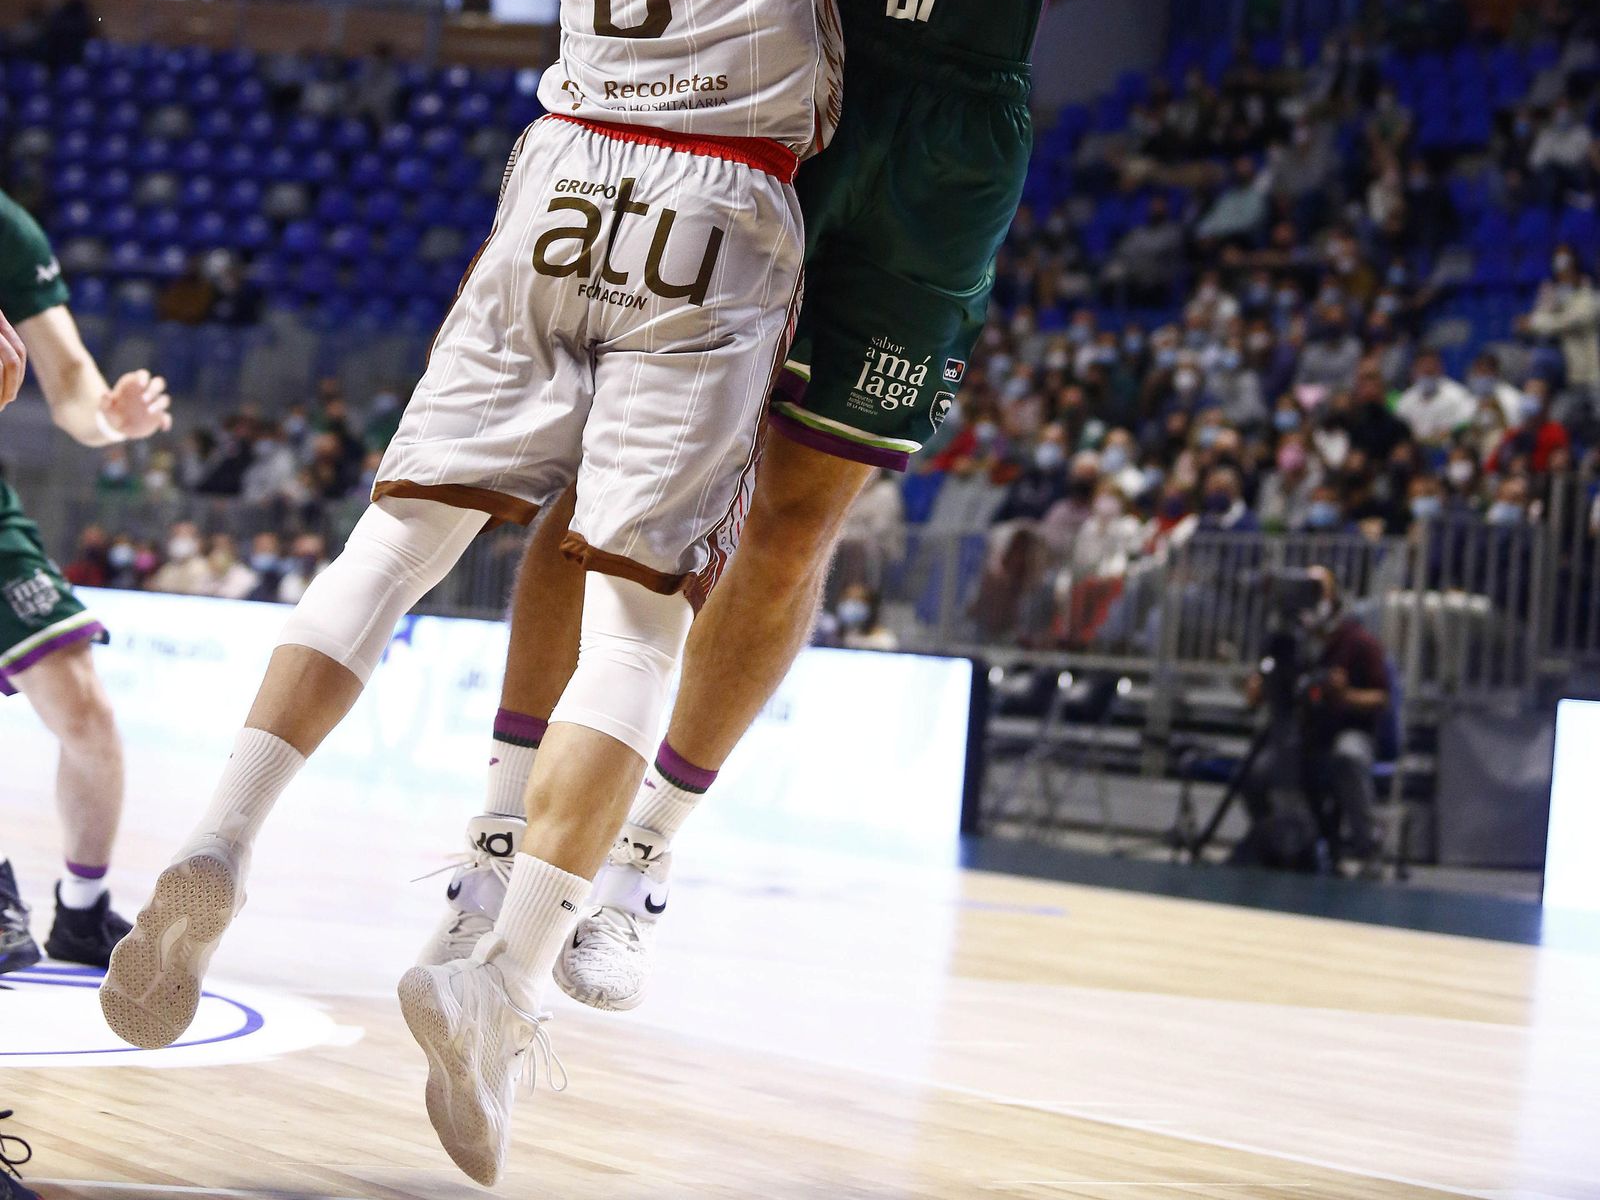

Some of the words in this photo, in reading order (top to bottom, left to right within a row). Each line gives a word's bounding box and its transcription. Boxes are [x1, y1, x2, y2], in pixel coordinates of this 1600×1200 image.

[604, 73, 729, 100] Recoletas
[629, 96, 728, 112] HOSPITALARIA
[554, 178, 617, 199] GRUPO
[532, 177, 725, 308] atu
[871, 336, 906, 355] sabor
